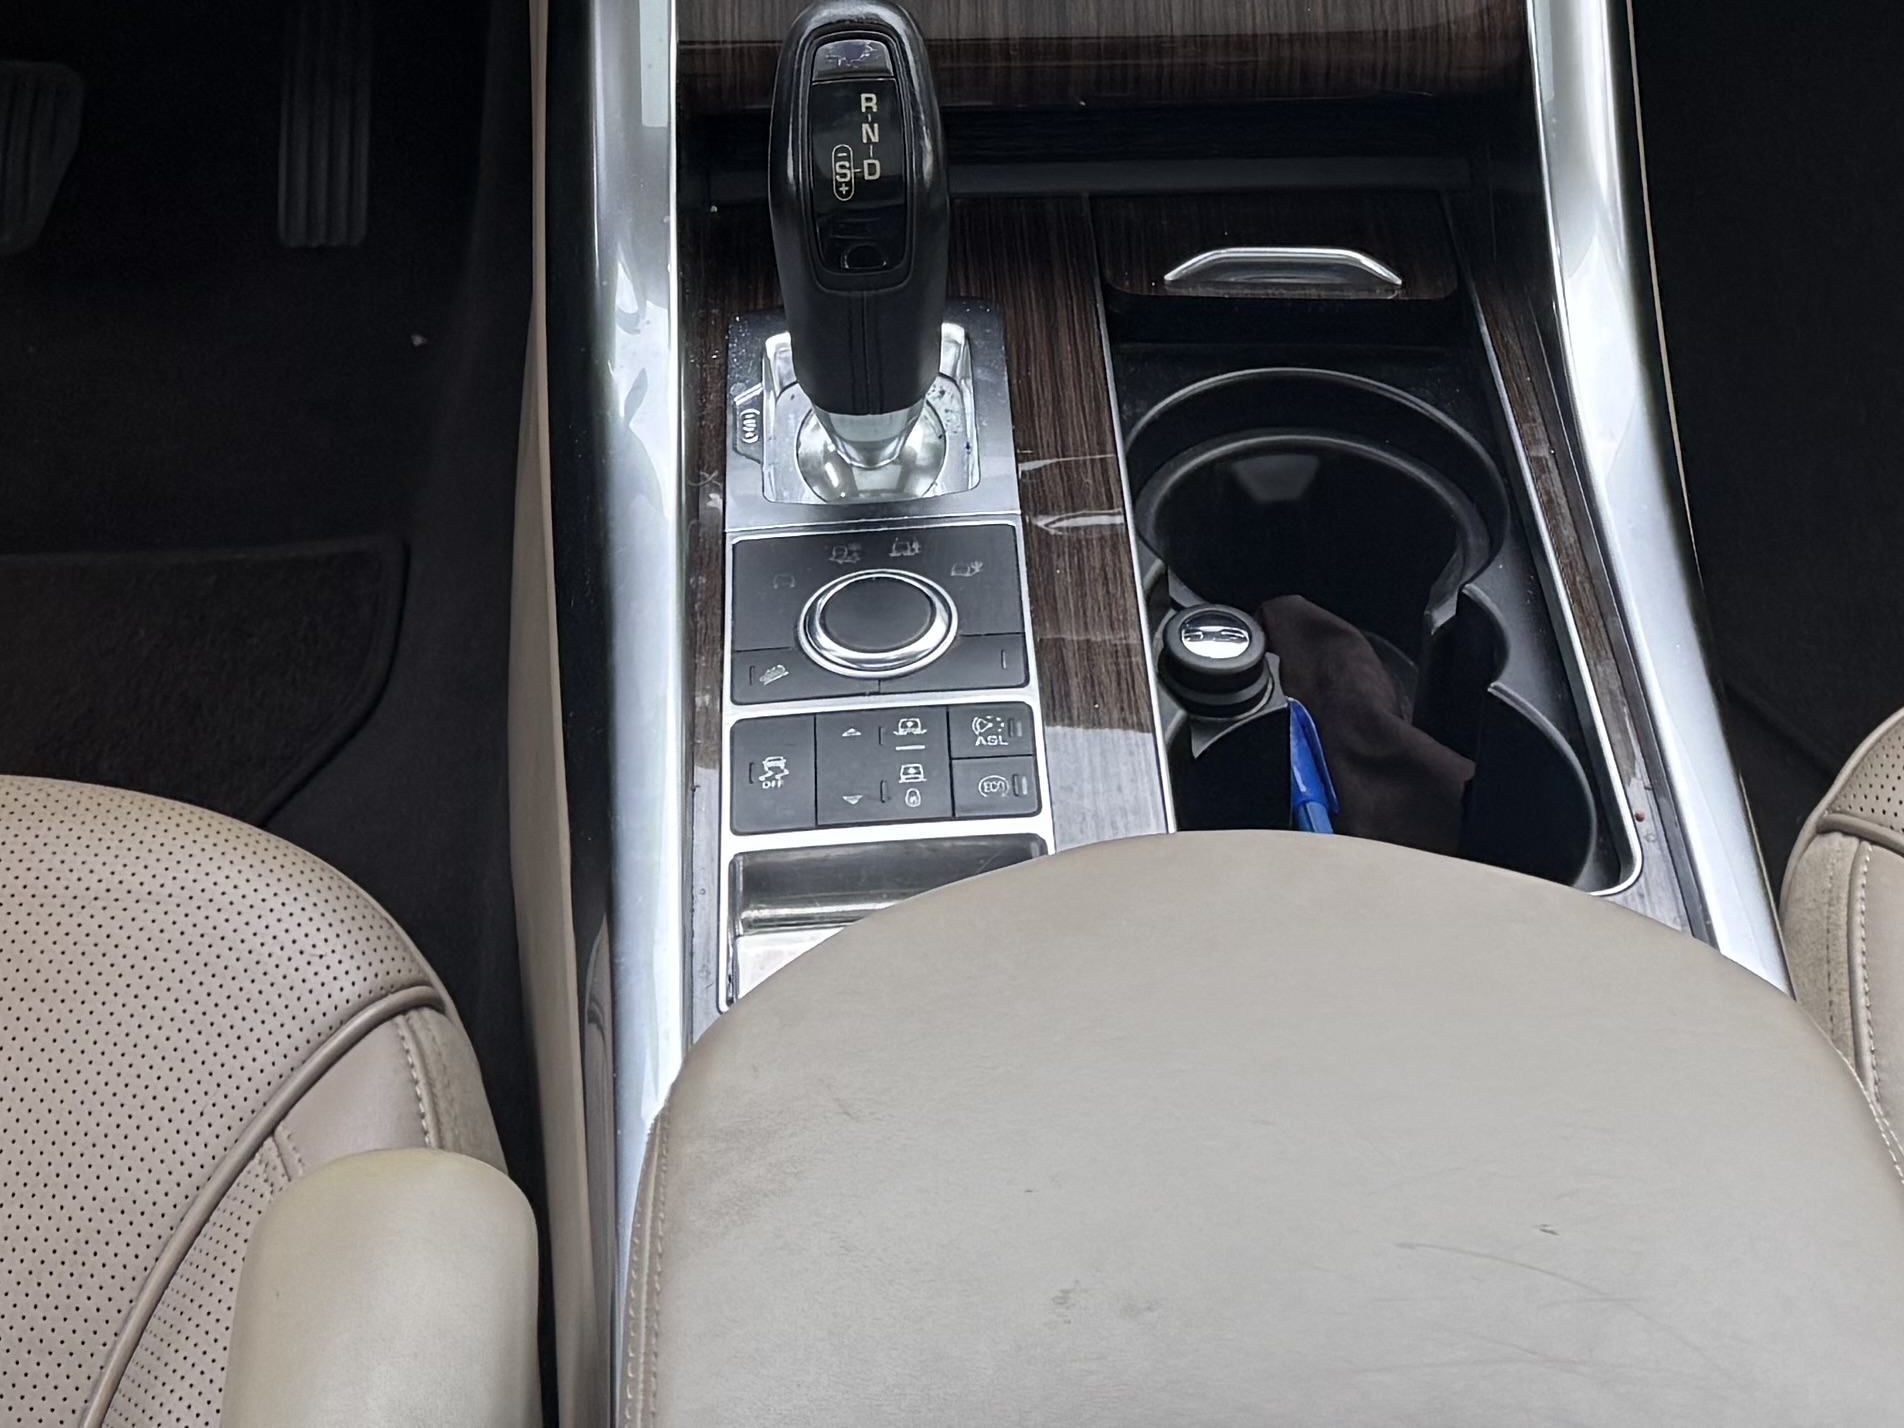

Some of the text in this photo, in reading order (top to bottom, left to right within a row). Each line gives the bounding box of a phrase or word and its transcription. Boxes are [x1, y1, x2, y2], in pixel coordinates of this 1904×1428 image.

[860, 93, 877, 113] R
[861, 123, 879, 144] N
[836, 161, 851, 182] S
[863, 159, 881, 180] D
